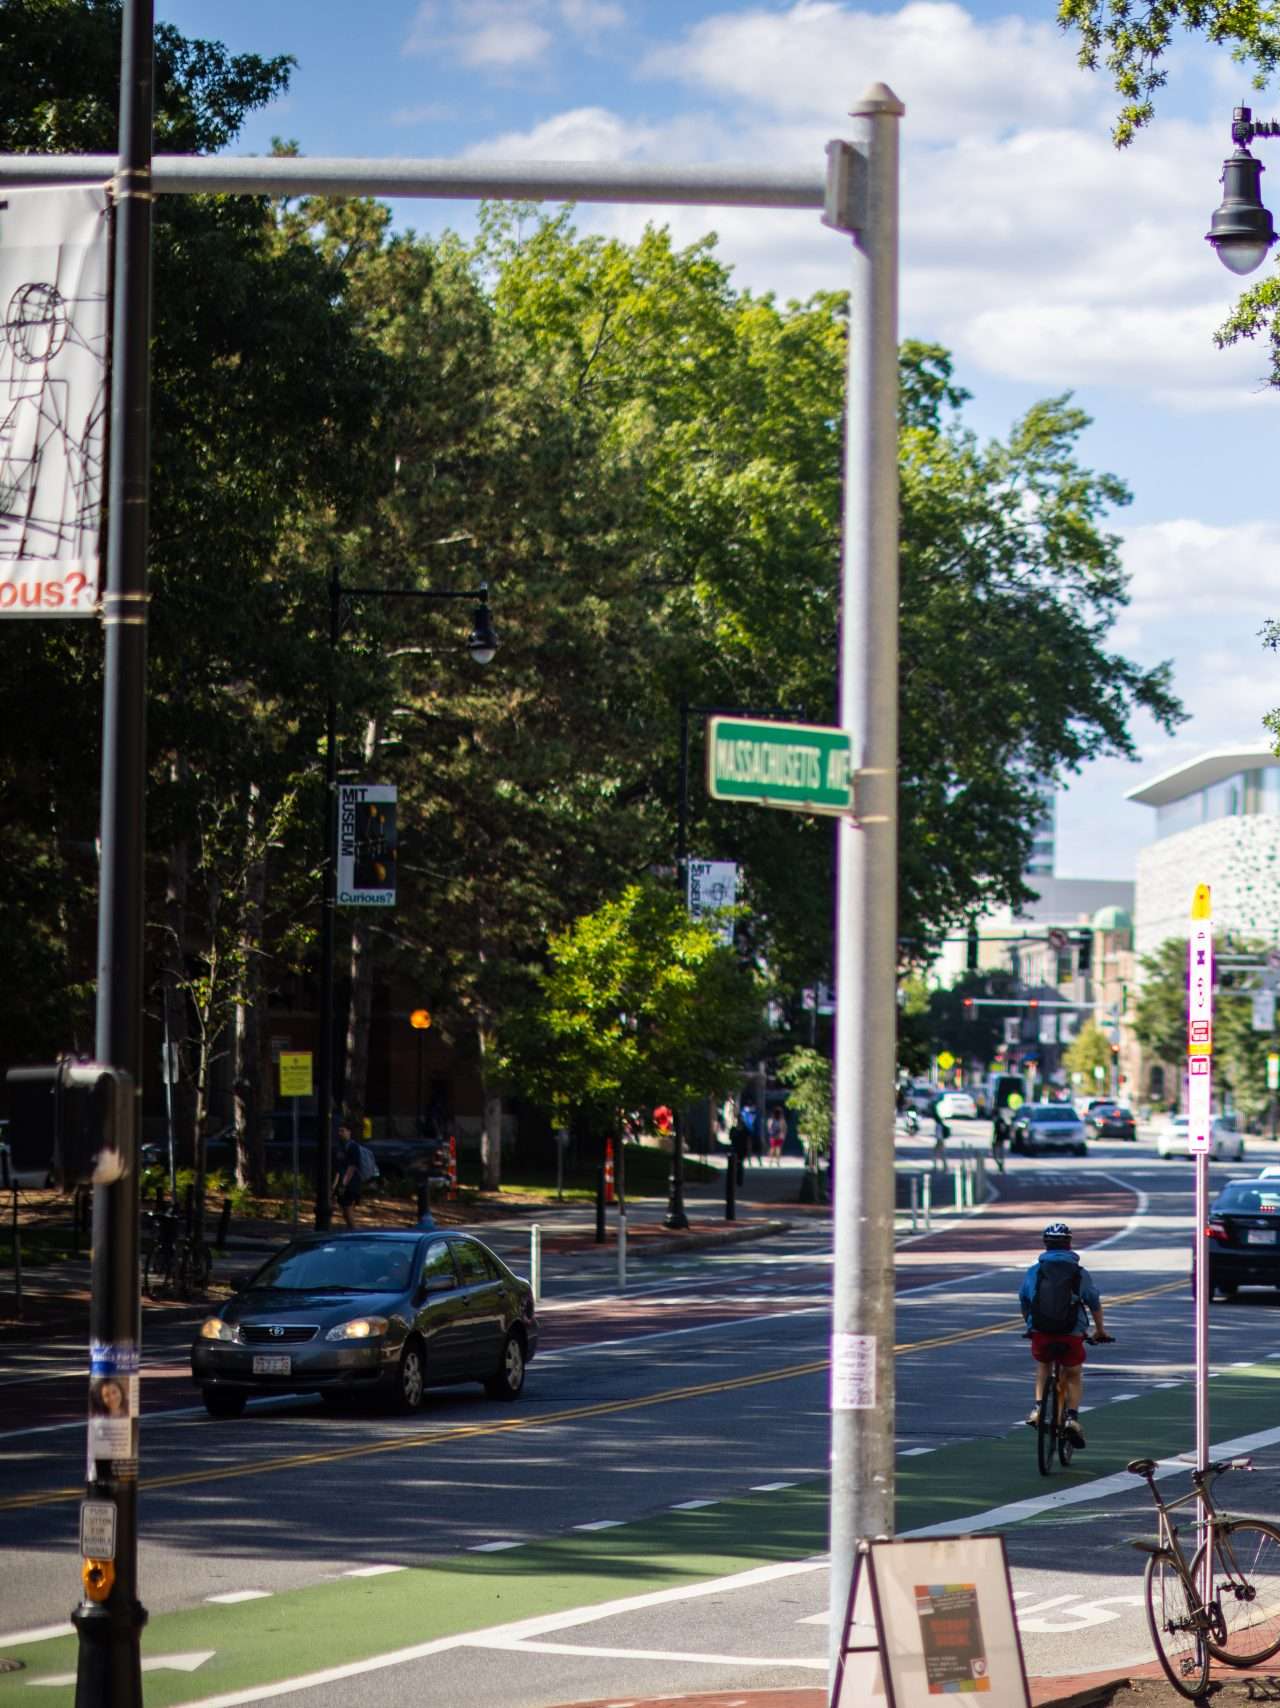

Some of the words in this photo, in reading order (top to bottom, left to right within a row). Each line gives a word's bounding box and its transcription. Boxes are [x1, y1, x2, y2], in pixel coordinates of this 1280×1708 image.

[716, 739, 821, 789] MASSACHUSETTS
[342, 788, 367, 800] MIT
[340, 892, 392, 904] Curious?
